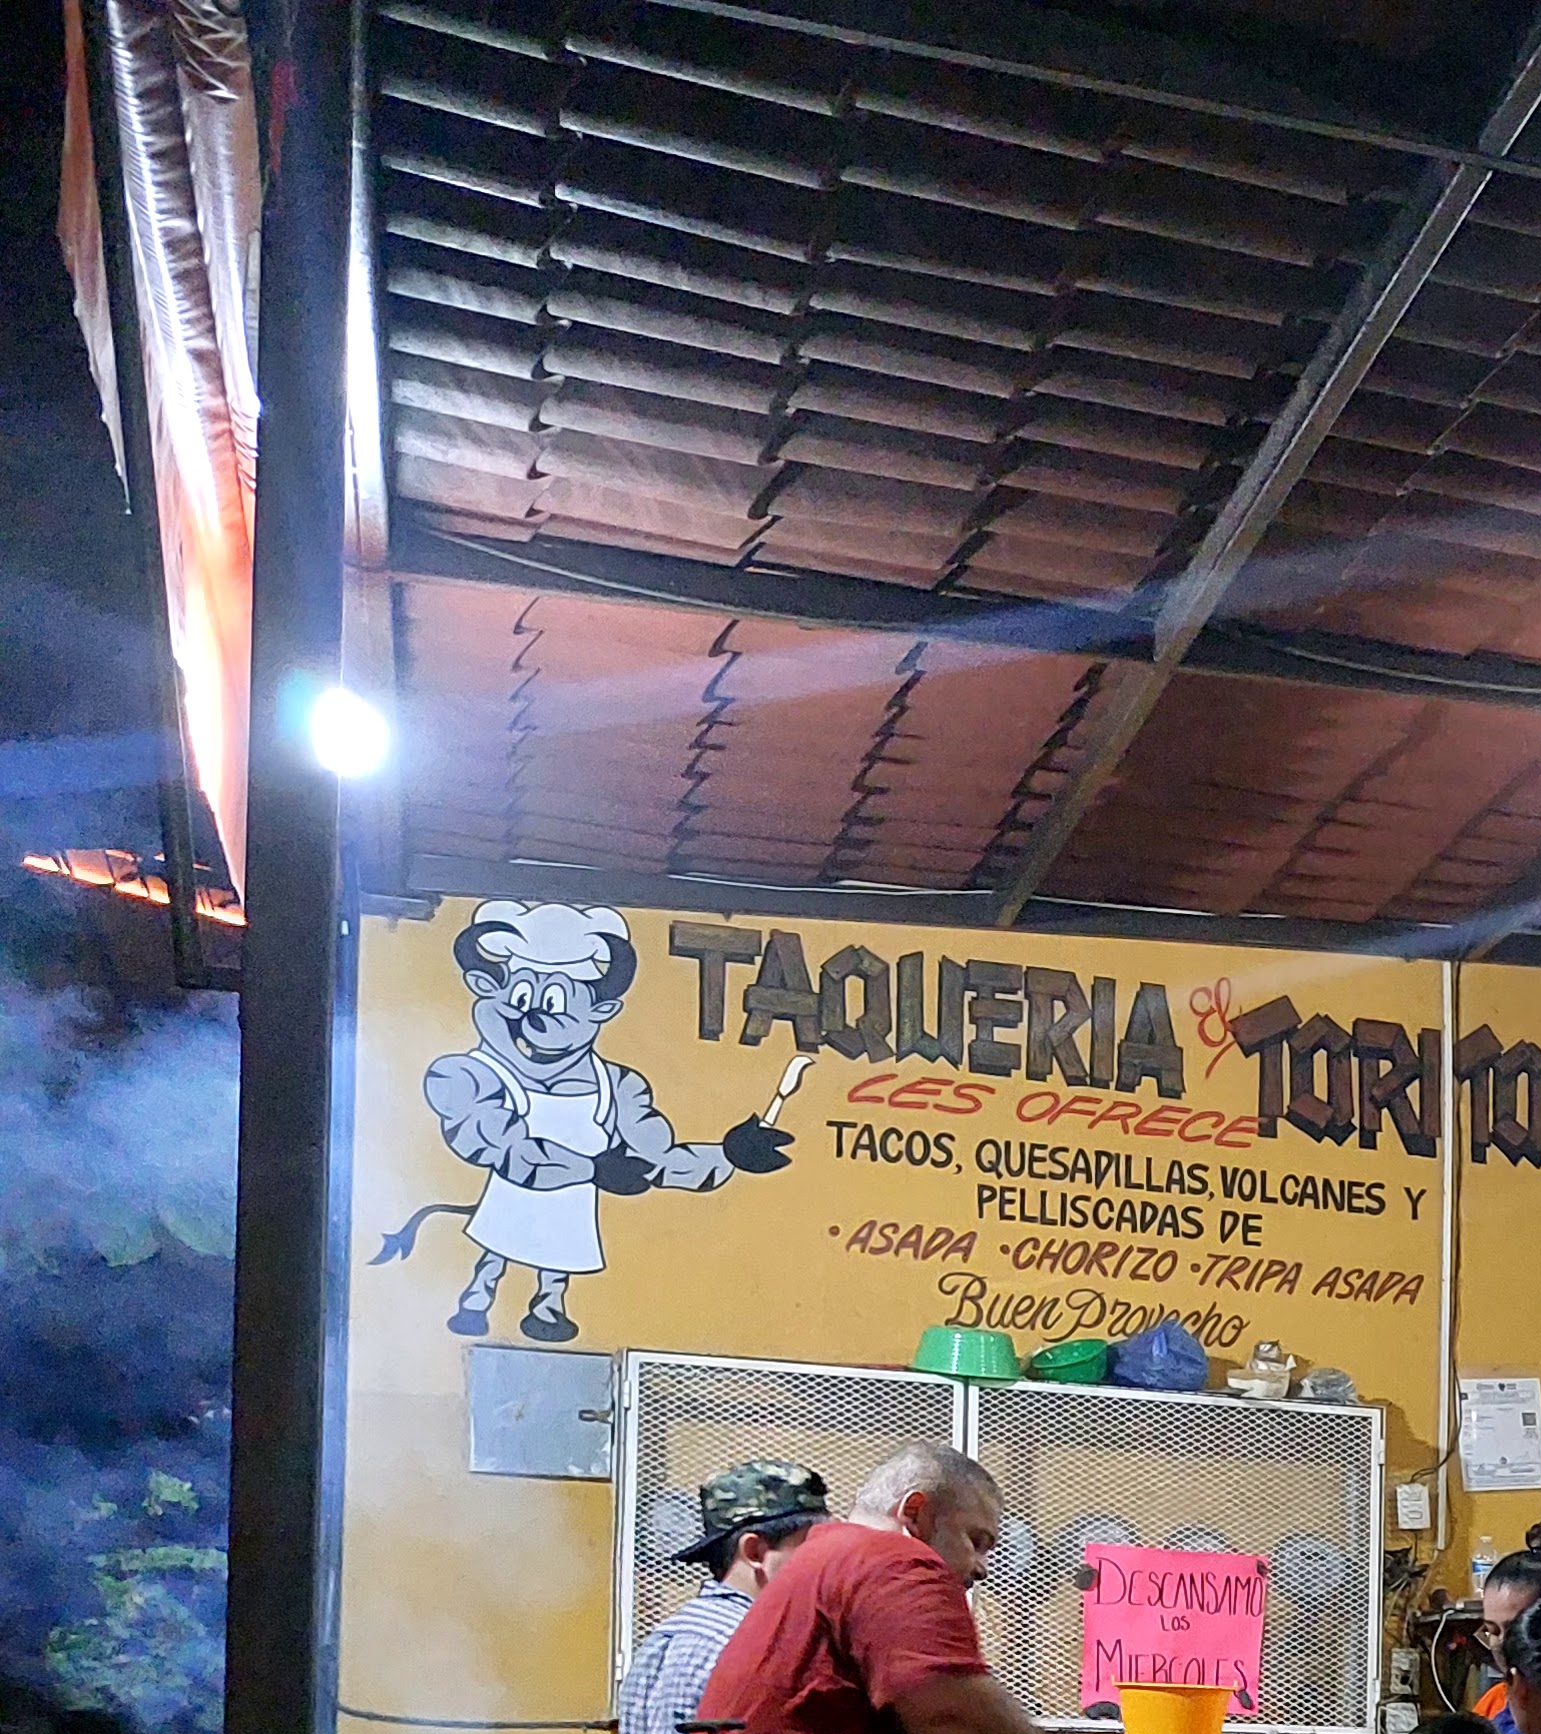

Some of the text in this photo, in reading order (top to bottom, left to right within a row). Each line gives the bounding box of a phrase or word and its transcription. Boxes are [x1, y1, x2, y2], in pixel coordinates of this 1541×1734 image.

[669, 920, 1186, 1099] TAQUERIA
[847, 1073, 1258, 1149] LES OFRECE
[826, 1120, 1428, 1221] TACOS, QUESADILLAS, VOLCANES Y
[976, 1183, 1263, 1247] PELLISCADAS DE
[938, 1271, 1064, 1332] Buen
[1311, 1265, 1425, 1306] ASADA
[1160, 1614, 1191, 1632] LOS
